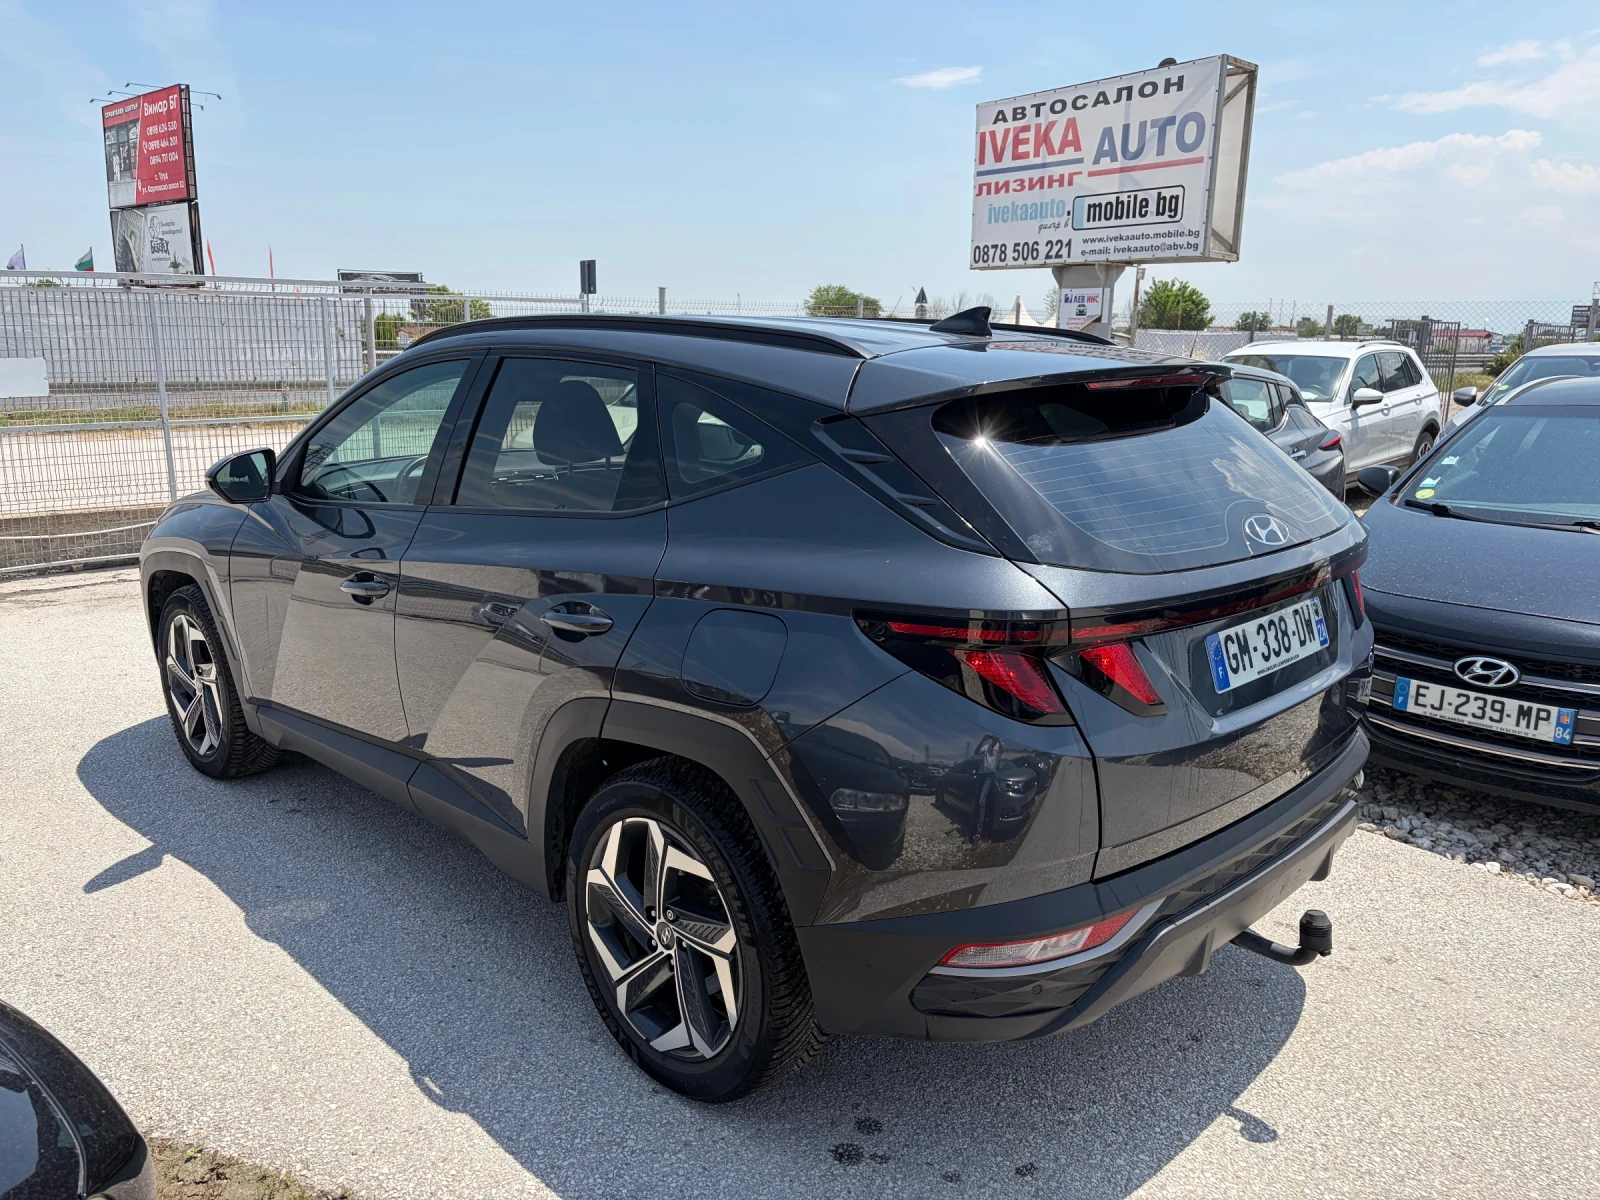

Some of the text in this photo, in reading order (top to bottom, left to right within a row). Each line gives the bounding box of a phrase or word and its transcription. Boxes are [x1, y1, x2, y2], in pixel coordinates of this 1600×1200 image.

[144, 94, 178, 117] Вимар БГ
[992, 75, 1185, 125] АВТОСАЛОН
[978, 111, 1206, 166] IVEKA AUTO
[975, 171, 1083, 197] ЛИЗИНГ
[1086, 191, 1180, 223] mobile.bg
[1080, 241, 1199, 256] e-mail: ivekaauto@abv.bg
[1082, 229, 1200, 244] www.ivekaauto.mobile.bg
[973, 238, 1072, 264] 0878 506 221
[1224, 604, 1316, 675] GM-338-DW
[1217, 666, 1225, 679] F
[1398, 696, 1405, 704] F
[1414, 684, 1552, 731] EJ-239-MP
[1554, 726, 1571, 741] 84
